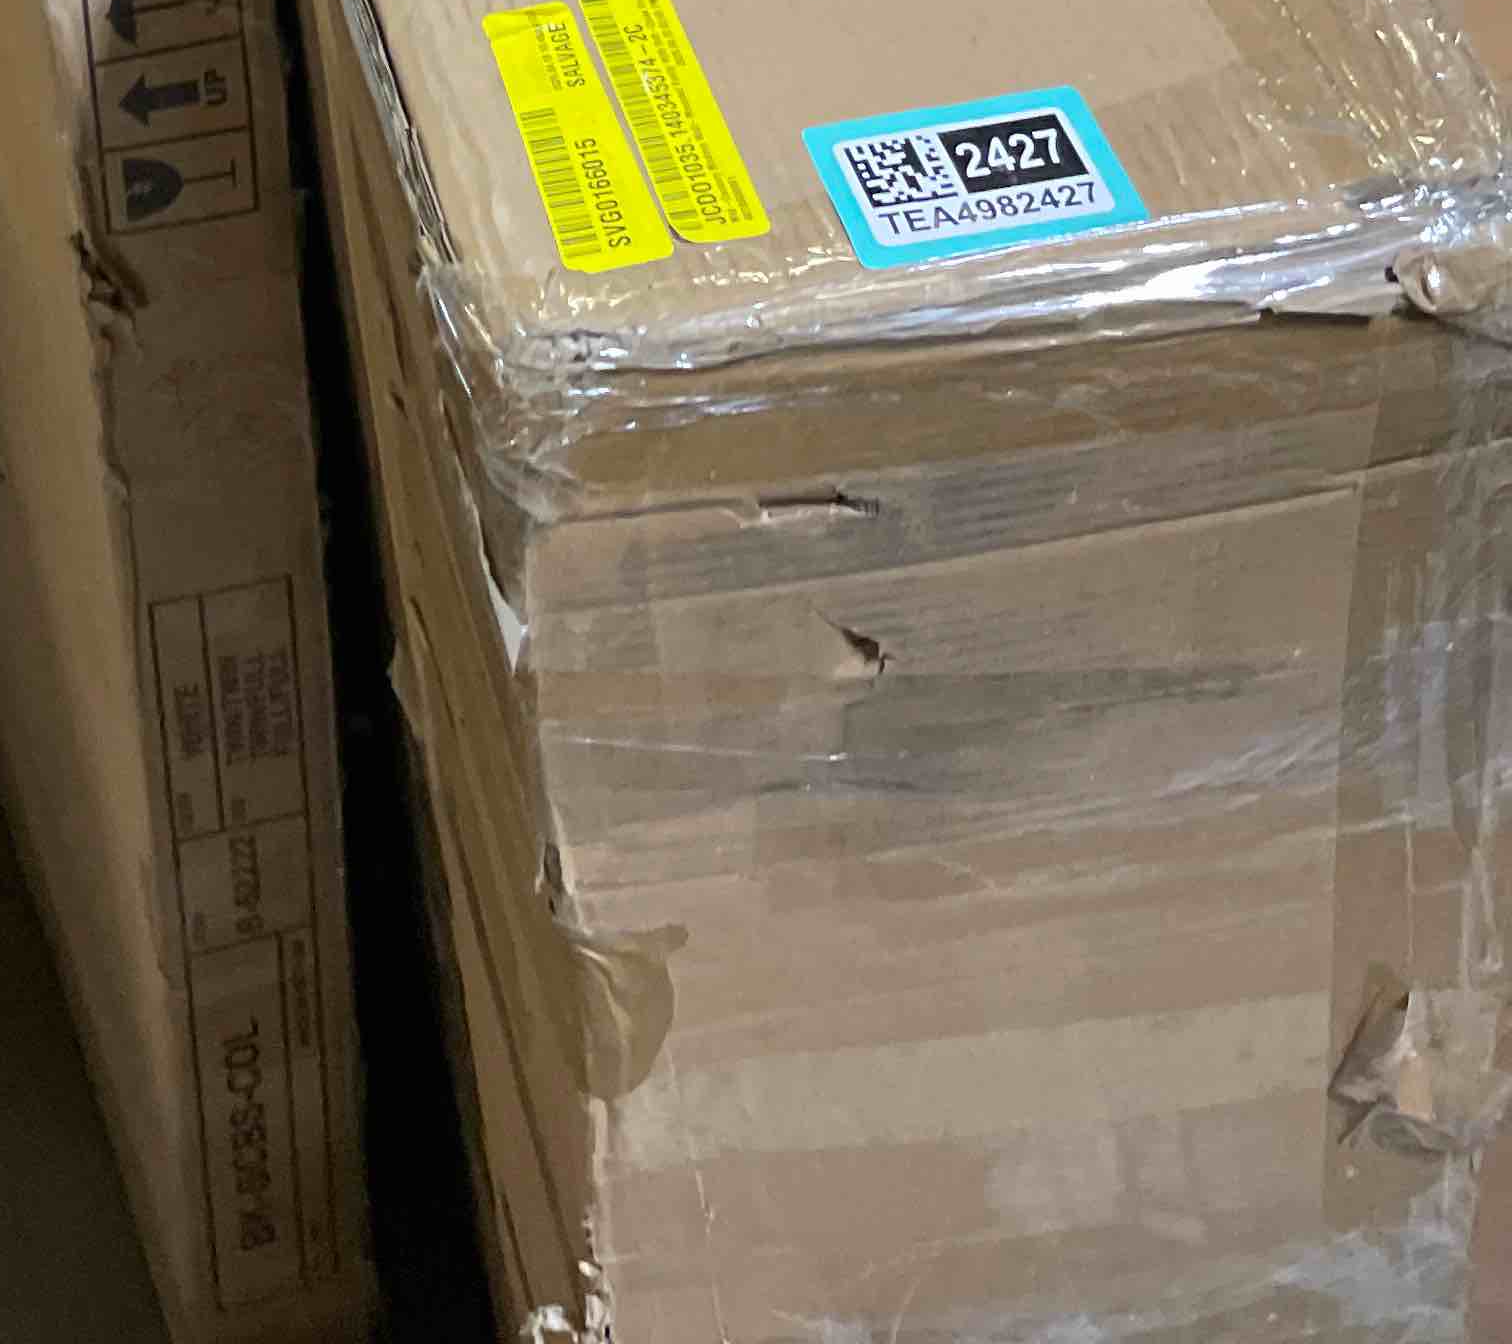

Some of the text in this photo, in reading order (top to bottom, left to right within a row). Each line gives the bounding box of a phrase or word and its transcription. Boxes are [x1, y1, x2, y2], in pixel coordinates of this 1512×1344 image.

[548, 22, 585, 89] SALVAGE
[203, 68, 227, 107] UP
[953, 127, 1062, 178] 2427
[574, 138, 632, 249] SVG0166015
[878, 181, 1096, 235] TEA4982427
